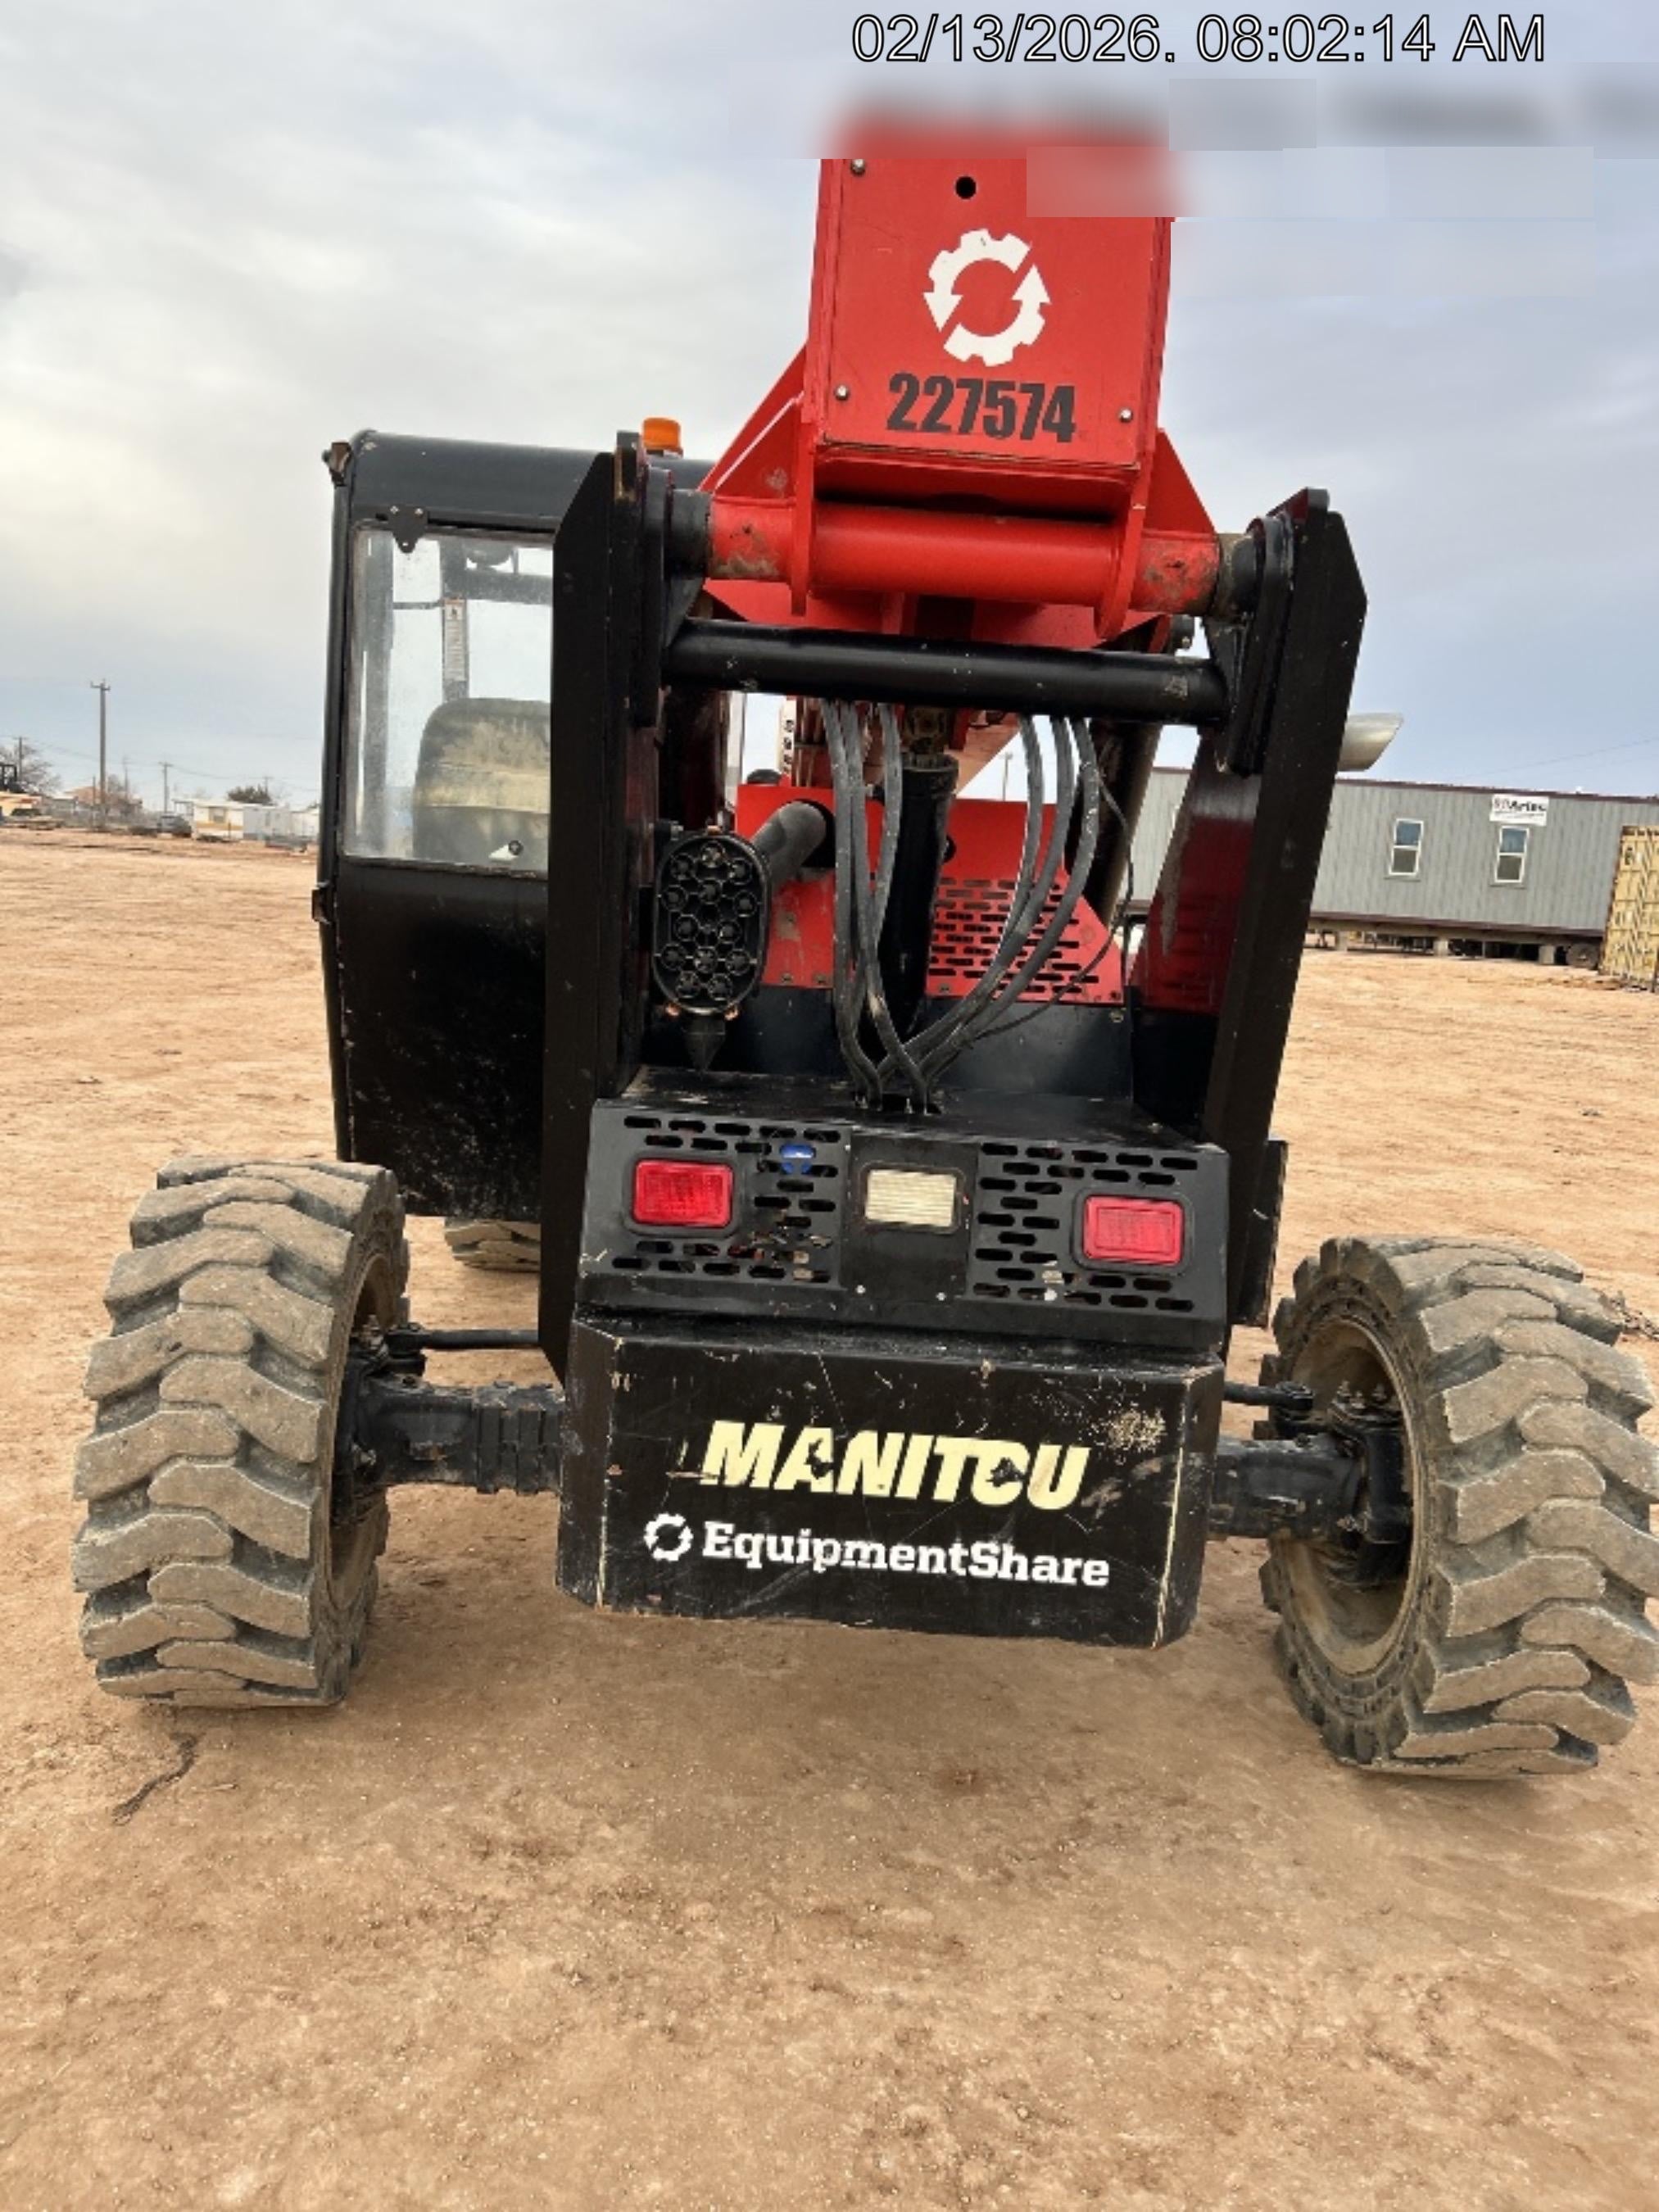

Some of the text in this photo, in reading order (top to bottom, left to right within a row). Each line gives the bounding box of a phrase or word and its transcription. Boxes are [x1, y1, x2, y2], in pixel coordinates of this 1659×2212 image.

[887, 372, 1076, 442] 227574
[700, 1420, 1090, 1510] MANITOU
[702, 1520, 1110, 1587] EquipmentShare
